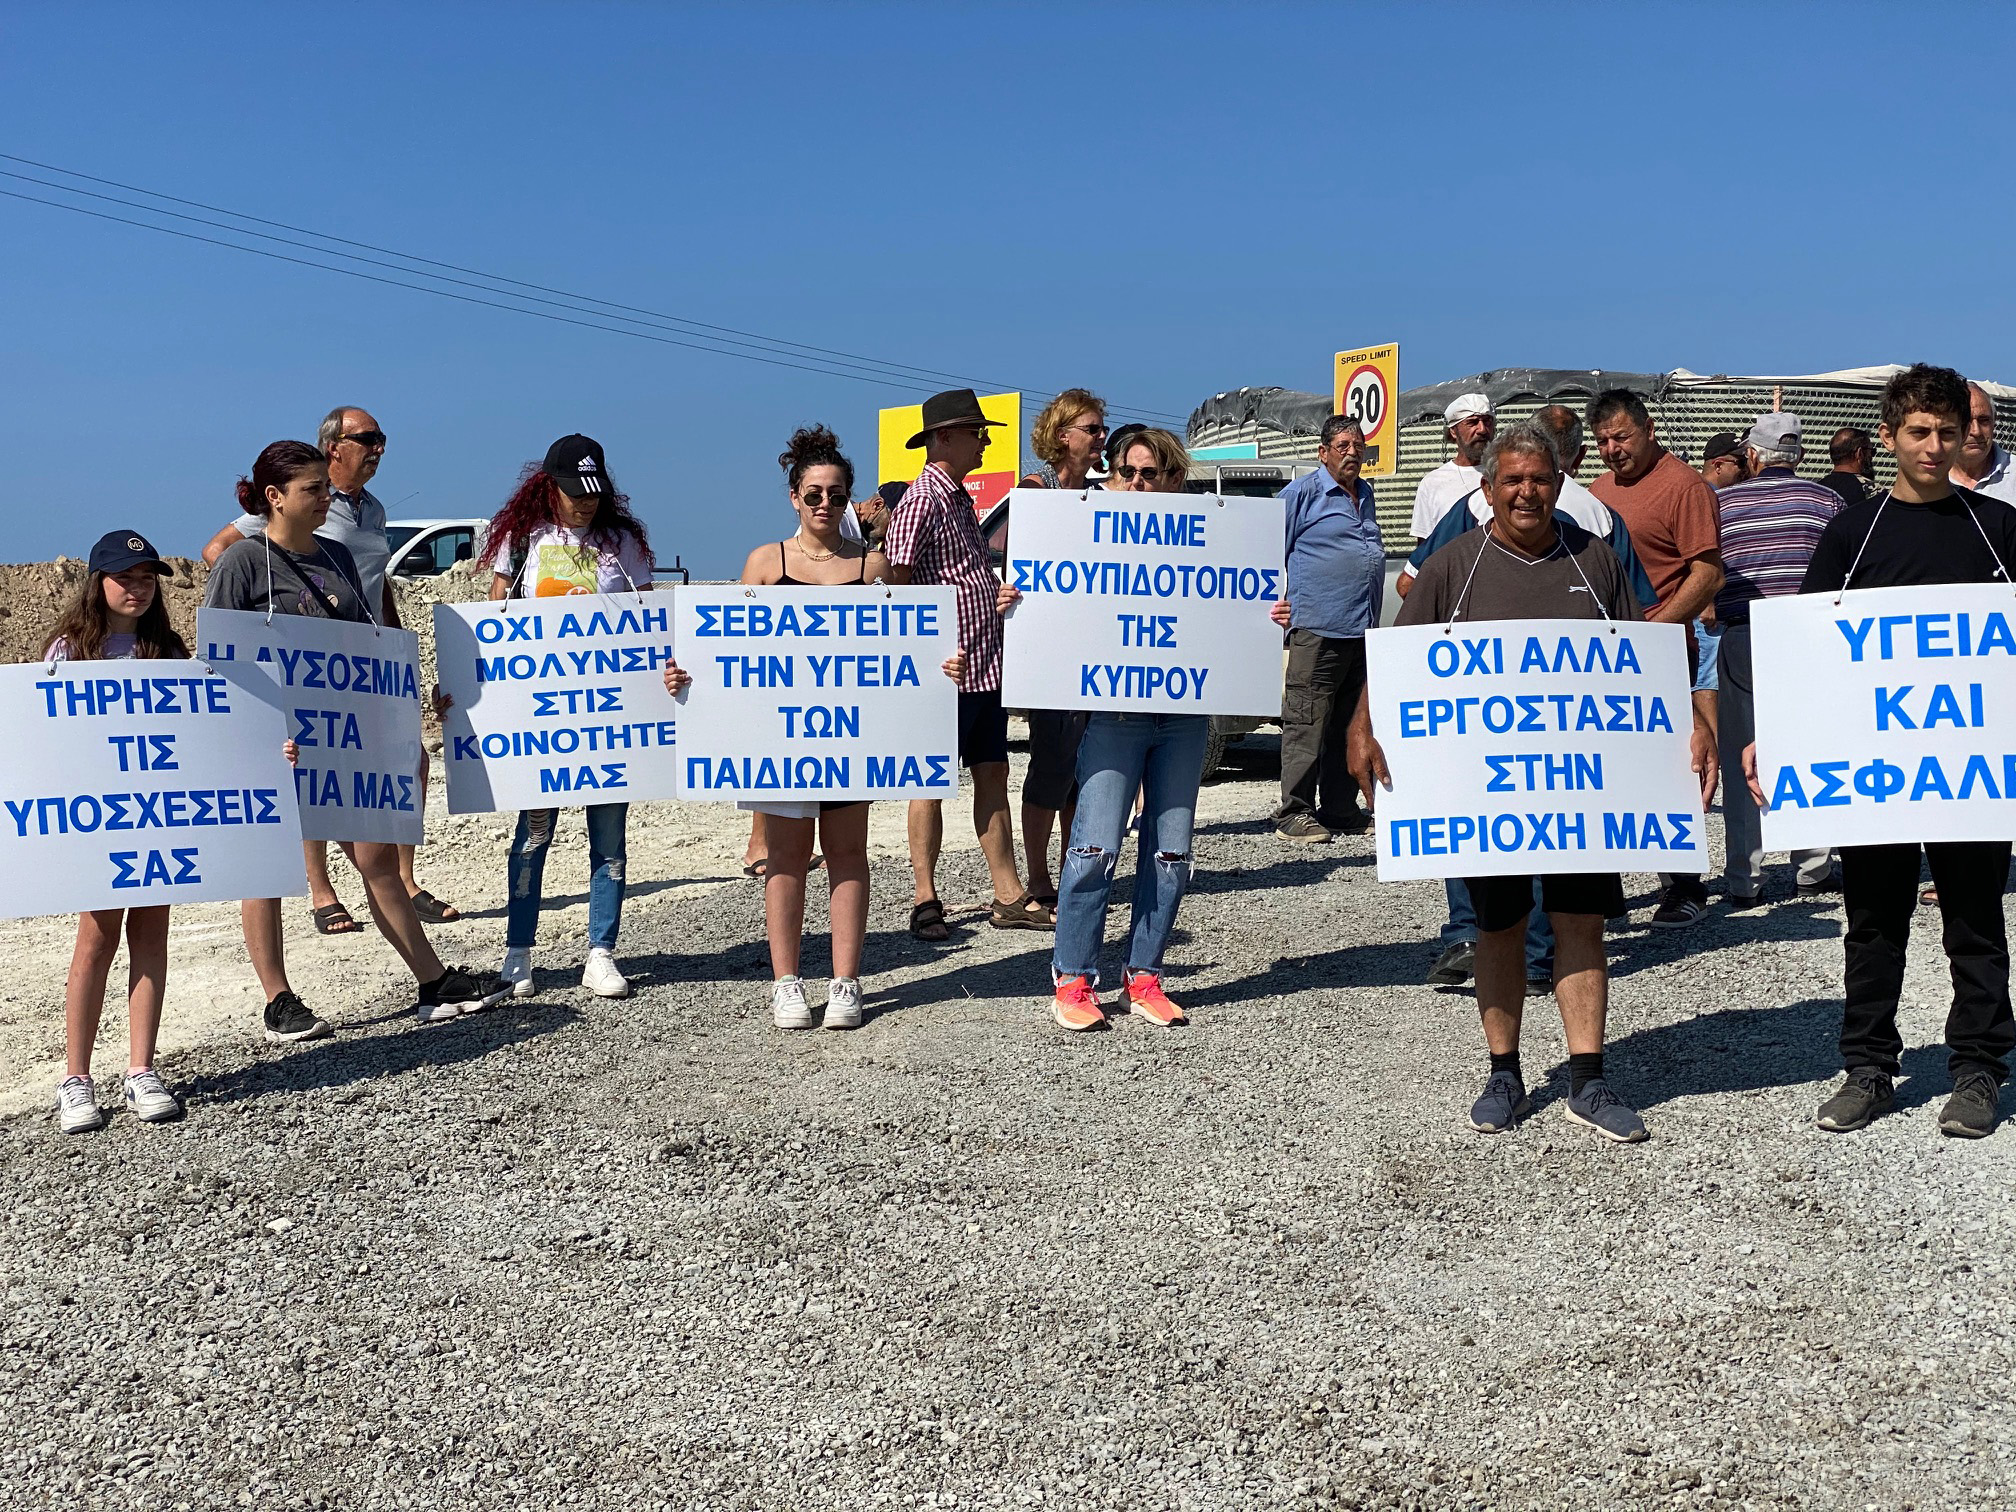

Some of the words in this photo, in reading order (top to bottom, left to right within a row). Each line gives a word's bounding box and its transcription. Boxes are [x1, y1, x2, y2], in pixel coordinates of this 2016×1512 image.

[1341, 353, 1367, 365] SPEED
[1370, 349, 1391, 360] LIMIT
[1350, 383, 1380, 423] 30
[578, 465, 597, 473] adidas
[1094, 511, 1206, 547] ΓΙΝΑΜΕ
[1012, 560, 1279, 600] ΣΚΟΥΠΙΔΟΤΟΠΟΣ
[476, 616, 543, 644] ΟΧΙ
[558, 608, 667, 638] ΑΛΛΗ
[696, 604, 939, 637] ΣΕΒΑΣΤΕΙΤΕ
[1117, 614, 1177, 648] ΤΗΣ
[1836, 612, 2016, 662] ΥΓΕΙΑ
[475, 646, 672, 683] ΜΟΛΥΝΣΗ
[715, 656, 793, 688] ΤΗΝ
[807, 656, 920, 687] ΥΓΕΙΑ
[1428, 638, 1504, 678] ΟΧΙ
[1520, 636, 1641, 674] ΑΛΛΑ
[36, 678, 230, 717] ΤΗΡΗΣΤΕ
[1081, 664, 1208, 700] ΚΥΠΡΟΥ
[532, 687, 623, 717] ΣΤΙΣ
[1400, 694, 1673, 738] ΕΡΓΟΣΤΑΣΙΑ
[1875, 684, 1984, 731] ΚΑΙ
[294, 709, 362, 750] ΣΤΑ
[454, 721, 675, 761] ΚΟΙΝΟΤΗΤΕ
[778, 706, 859, 738] ΤΩΝ
[108, 734, 179, 772] ΤΙΣ
[687, 756, 849, 788] ΠΑΙΔΙΩΝ
[867, 756, 950, 788] ΜΑΣ
[353, 771, 414, 811] ΜΑΣ
[540, 763, 627, 793] ΜΑΣ
[1485, 753, 1603, 792] ΣΤΗΝ
[4, 788, 280, 836] ΥΠΟΣΧΕΣΕΙΣ
[1390, 813, 1586, 856] ΠΕΡΙΟΧΗ
[1603, 812, 1696, 850] ΜΑΣ
[109, 848, 201, 888] ΣΑΣ
